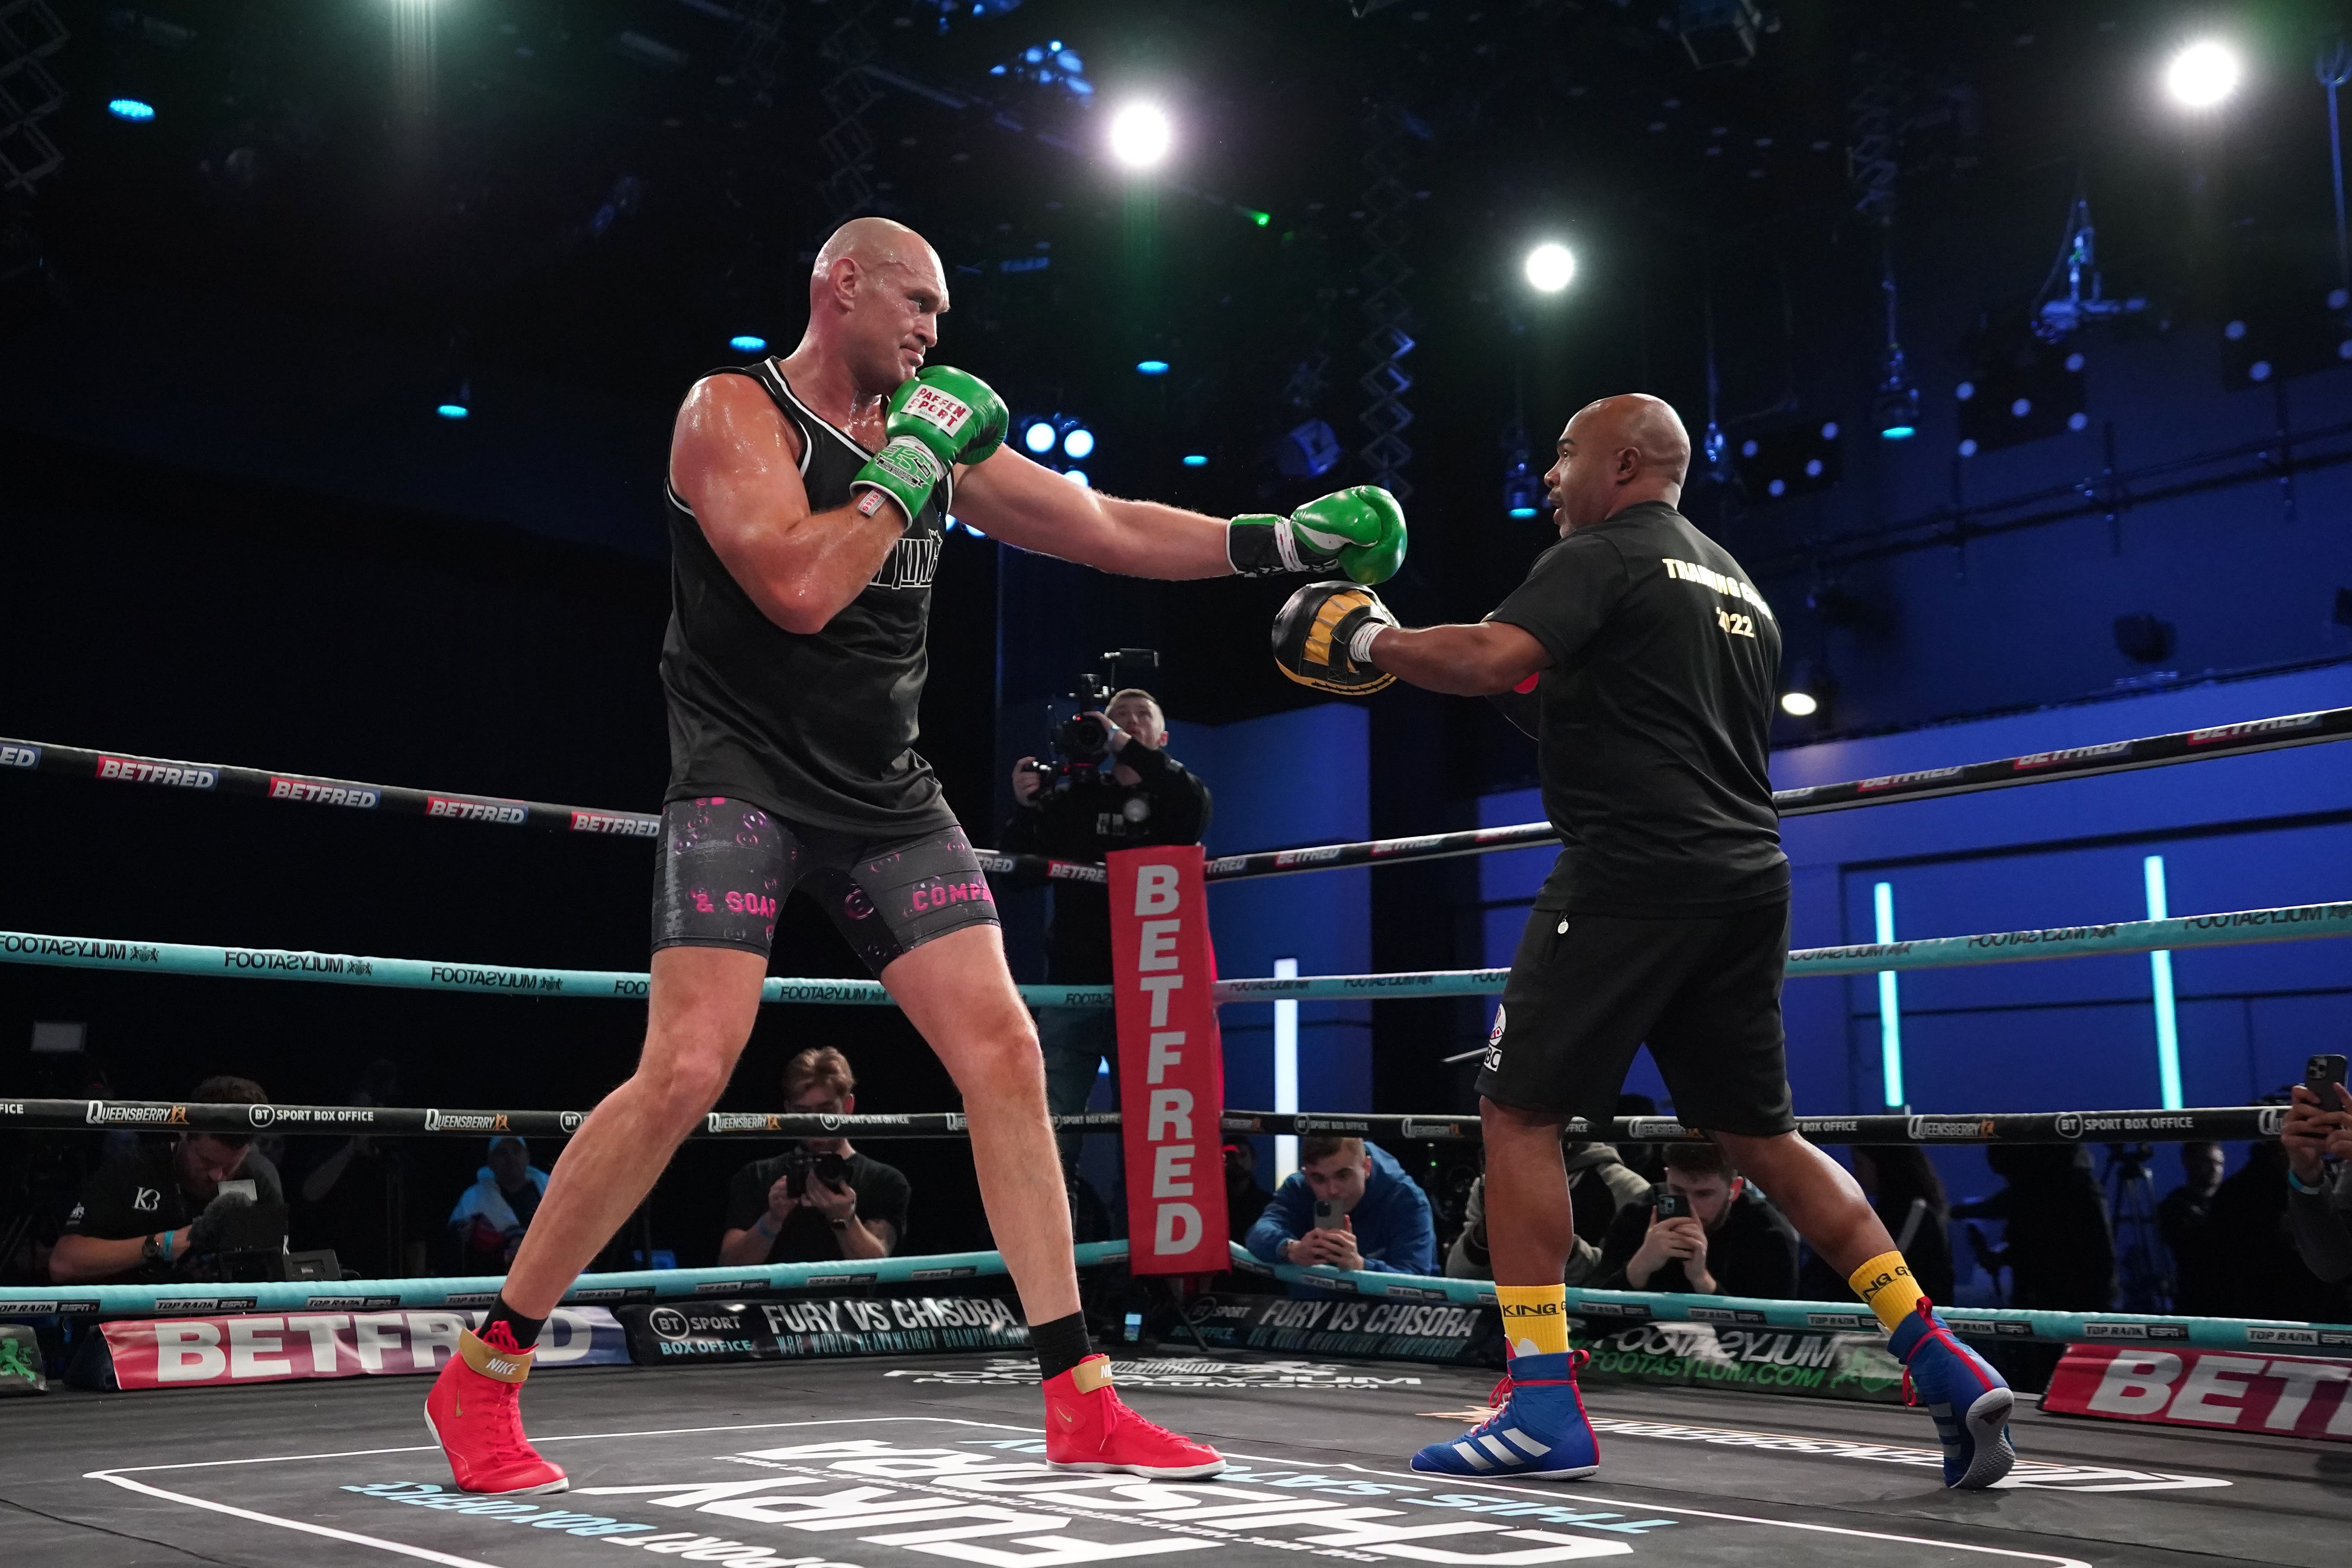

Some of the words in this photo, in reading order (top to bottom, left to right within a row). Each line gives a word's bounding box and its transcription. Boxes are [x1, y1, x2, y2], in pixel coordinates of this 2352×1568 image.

[908, 398, 957, 427] SPORT
[916, 388, 966, 418] PAFFEN
[1662, 558, 1741, 597] TRAINING
[101, 760, 214, 788] BETFRED
[273, 781, 376, 809] BETFRED
[429, 800, 524, 824] BETFRED
[574, 815, 659, 837] BETFRED
[1049, 863, 1107, 883] BETFRE
[725, 891, 776, 919] SOAP
[224, 951, 344, 974] FOOTASYLUM
[431, 967, 537, 989] FOOTASYLUM
[1135, 865, 1204, 1256] BETFRED
[0, 1104, 24, 1114] FICE
[86, 1101, 171, 1124] QUEENSBERRY
[255, 1109, 269, 1120] BT
[277, 1110, 310, 1121] SPORT
[314, 1111, 335, 1121] BOX
[337, 1111, 374, 1121] OFFICE
[425, 1109, 495, 1130] QUEENSBERRY
[565, 1116, 577, 1126] BT
[708, 1113, 766, 1132] QUEENSBERRY
[2062, 1119, 2076, 1130] BT
[2085, 1119, 2120, 1131] SPORT
[2124, 1118, 2149, 1130] BOX
[2151, 1117, 2193, 1129] OFFICE
[761, 1301, 841, 1333] FURY
[844, 1301, 891, 1331] VS
[891, 1297, 1017, 1328] CHISORA
[1259, 1299, 1332, 1329] FURY
[1329, 1302, 1367, 1331] VS
[1365, 1304, 1481, 1337] CHISORA
[1504, 1304, 1556, 1316] KING
[658, 1317, 680, 1331] BT
[690, 1316, 741, 1330] SPORT
[154, 1309, 592, 1382] BETFRD
[660, 1341, 691, 1355] BOX
[698, 1339, 751, 1353] OFFICE
[2249, 1331, 2273, 1341] TOP
[2277, 1332, 2314, 1343] RANK
[485, 1358, 520, 1375] NIKE
[882, 1370, 1422, 1384] FOOASYLUM
[338, 1482, 540, 1515] OFFICE
[489, 1510, 658, 1537] BOX
[1395, 1494, 1681, 1533] THIS
